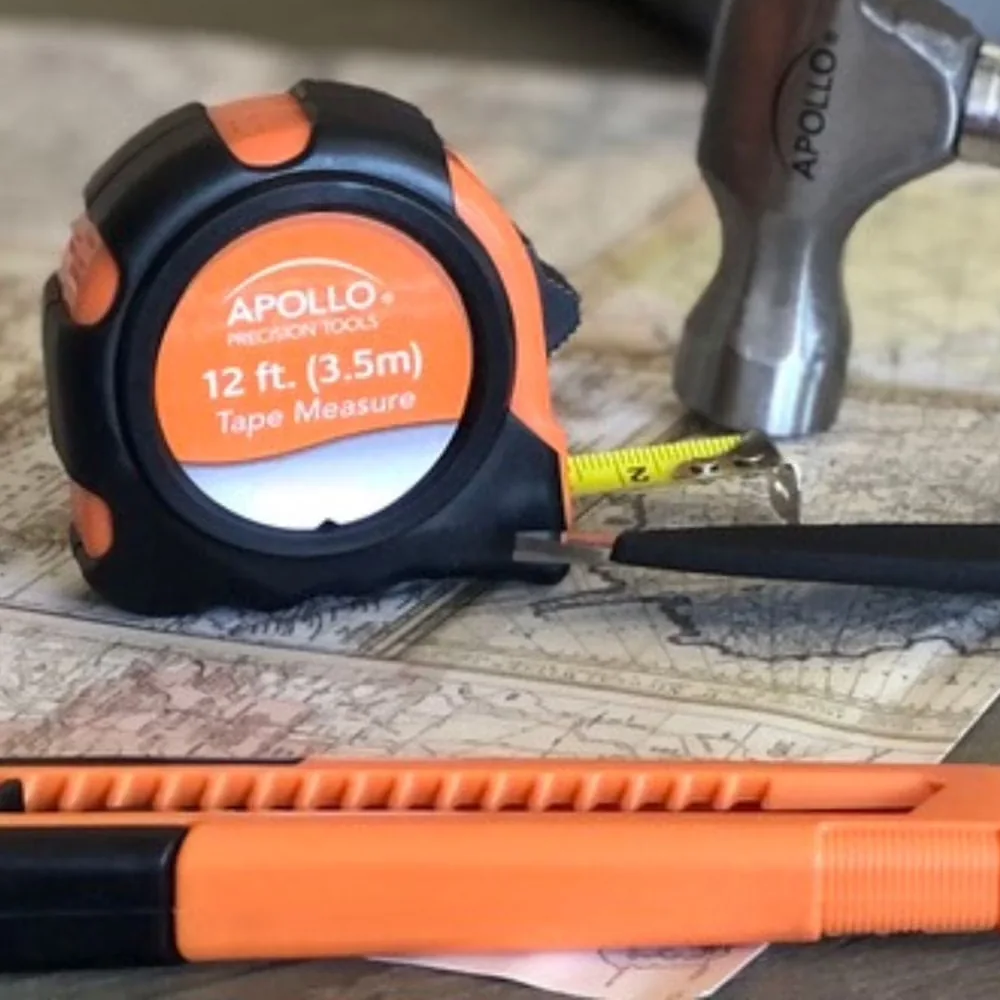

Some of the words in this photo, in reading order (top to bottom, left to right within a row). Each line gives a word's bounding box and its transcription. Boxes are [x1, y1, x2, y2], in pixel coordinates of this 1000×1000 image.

[792, 48, 837, 181] APOLLO
[227, 280, 376, 326] APOLLO
[227, 323, 317, 347] PRECISION
[322, 313, 379, 334] TOOLS
[202, 366, 245, 400] 12
[255, 360, 296, 393] ft.
[305, 340, 423, 394] (3.5m)
[216, 410, 285, 437] Tape
[293, 391, 417, 423] Measure
